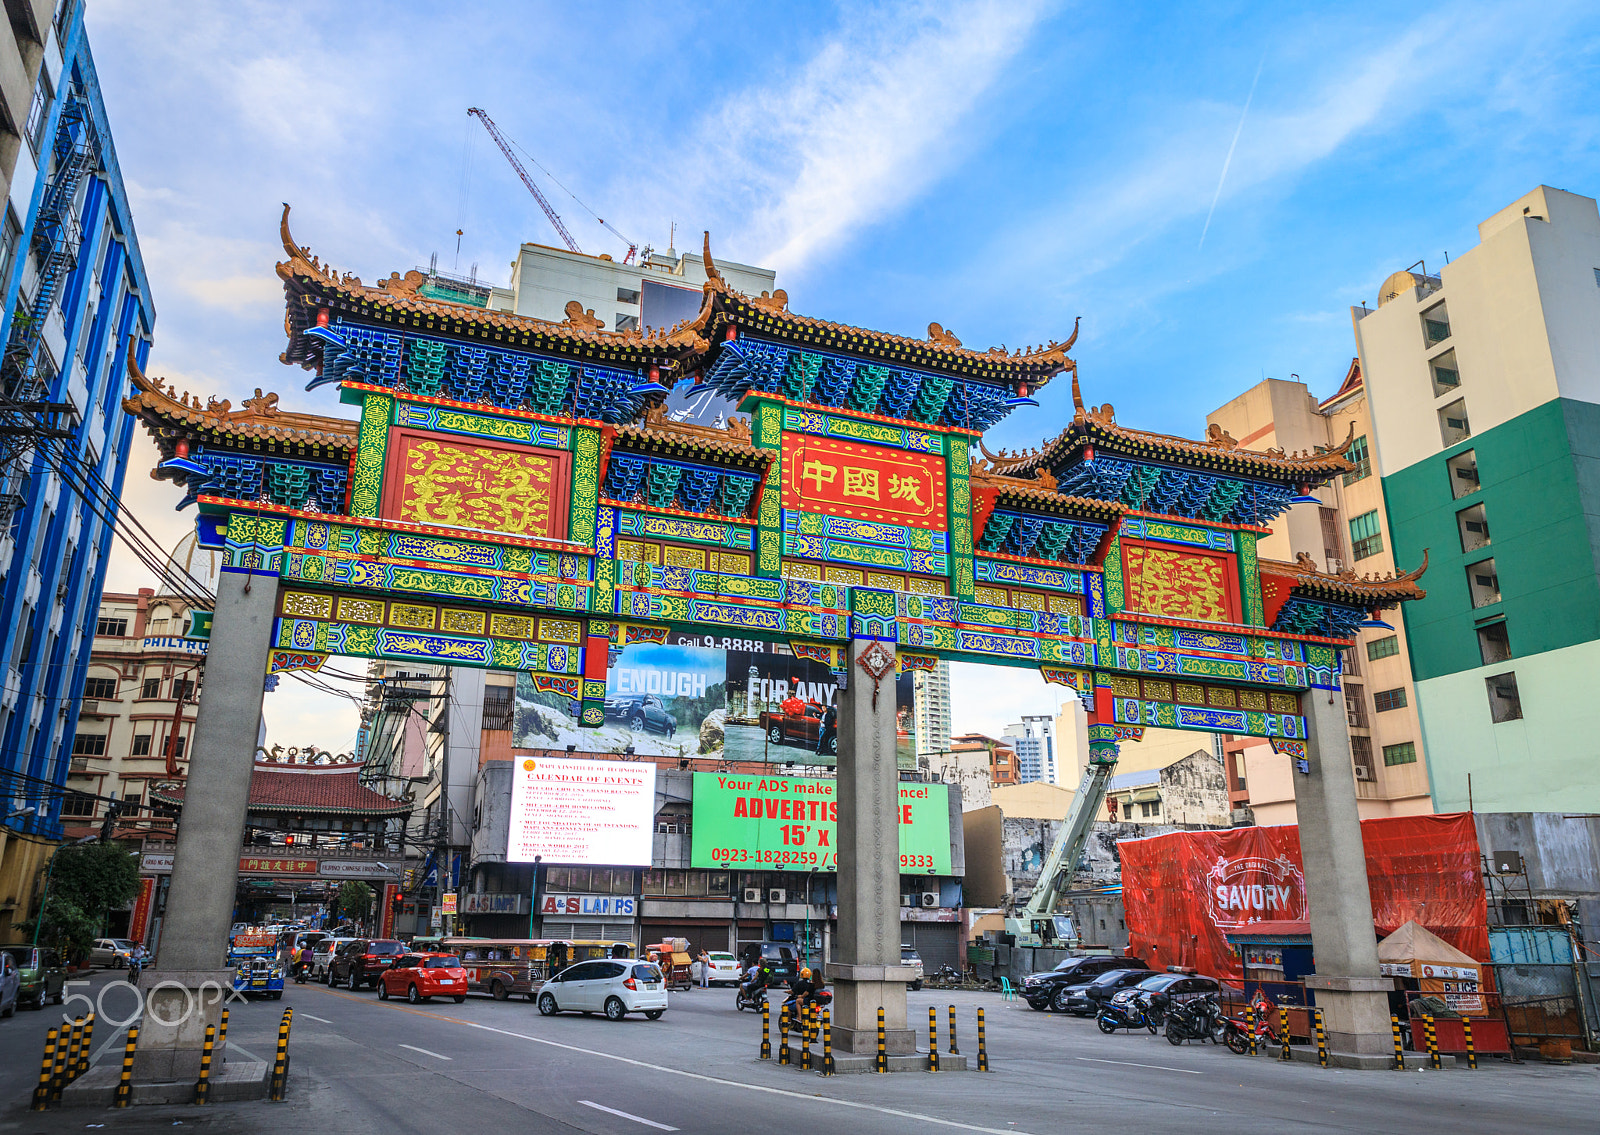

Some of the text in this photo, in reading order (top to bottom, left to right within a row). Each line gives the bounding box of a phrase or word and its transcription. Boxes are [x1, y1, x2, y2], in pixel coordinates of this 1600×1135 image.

[802, 460, 925, 506] 中國城
[143, 638, 208, 650] PHILTRU
[678, 636, 764, 652] Call 9-8888
[617, 668, 706, 698] ENOUGH
[748, 678, 837, 706] FOR ANY
[527, 774, 582, 782] CALENDAR
[718, 777, 752, 791] Your
[758, 780, 789, 793] ADS
[794, 782, 832, 795] make
[733, 797, 837, 822] ADVERTIS
[780, 825, 830, 846] 15' x
[711, 848, 817, 864] 0923-1828259
[542, 897, 580, 913] A&S
[1216, 885, 1291, 911] SAVORY
